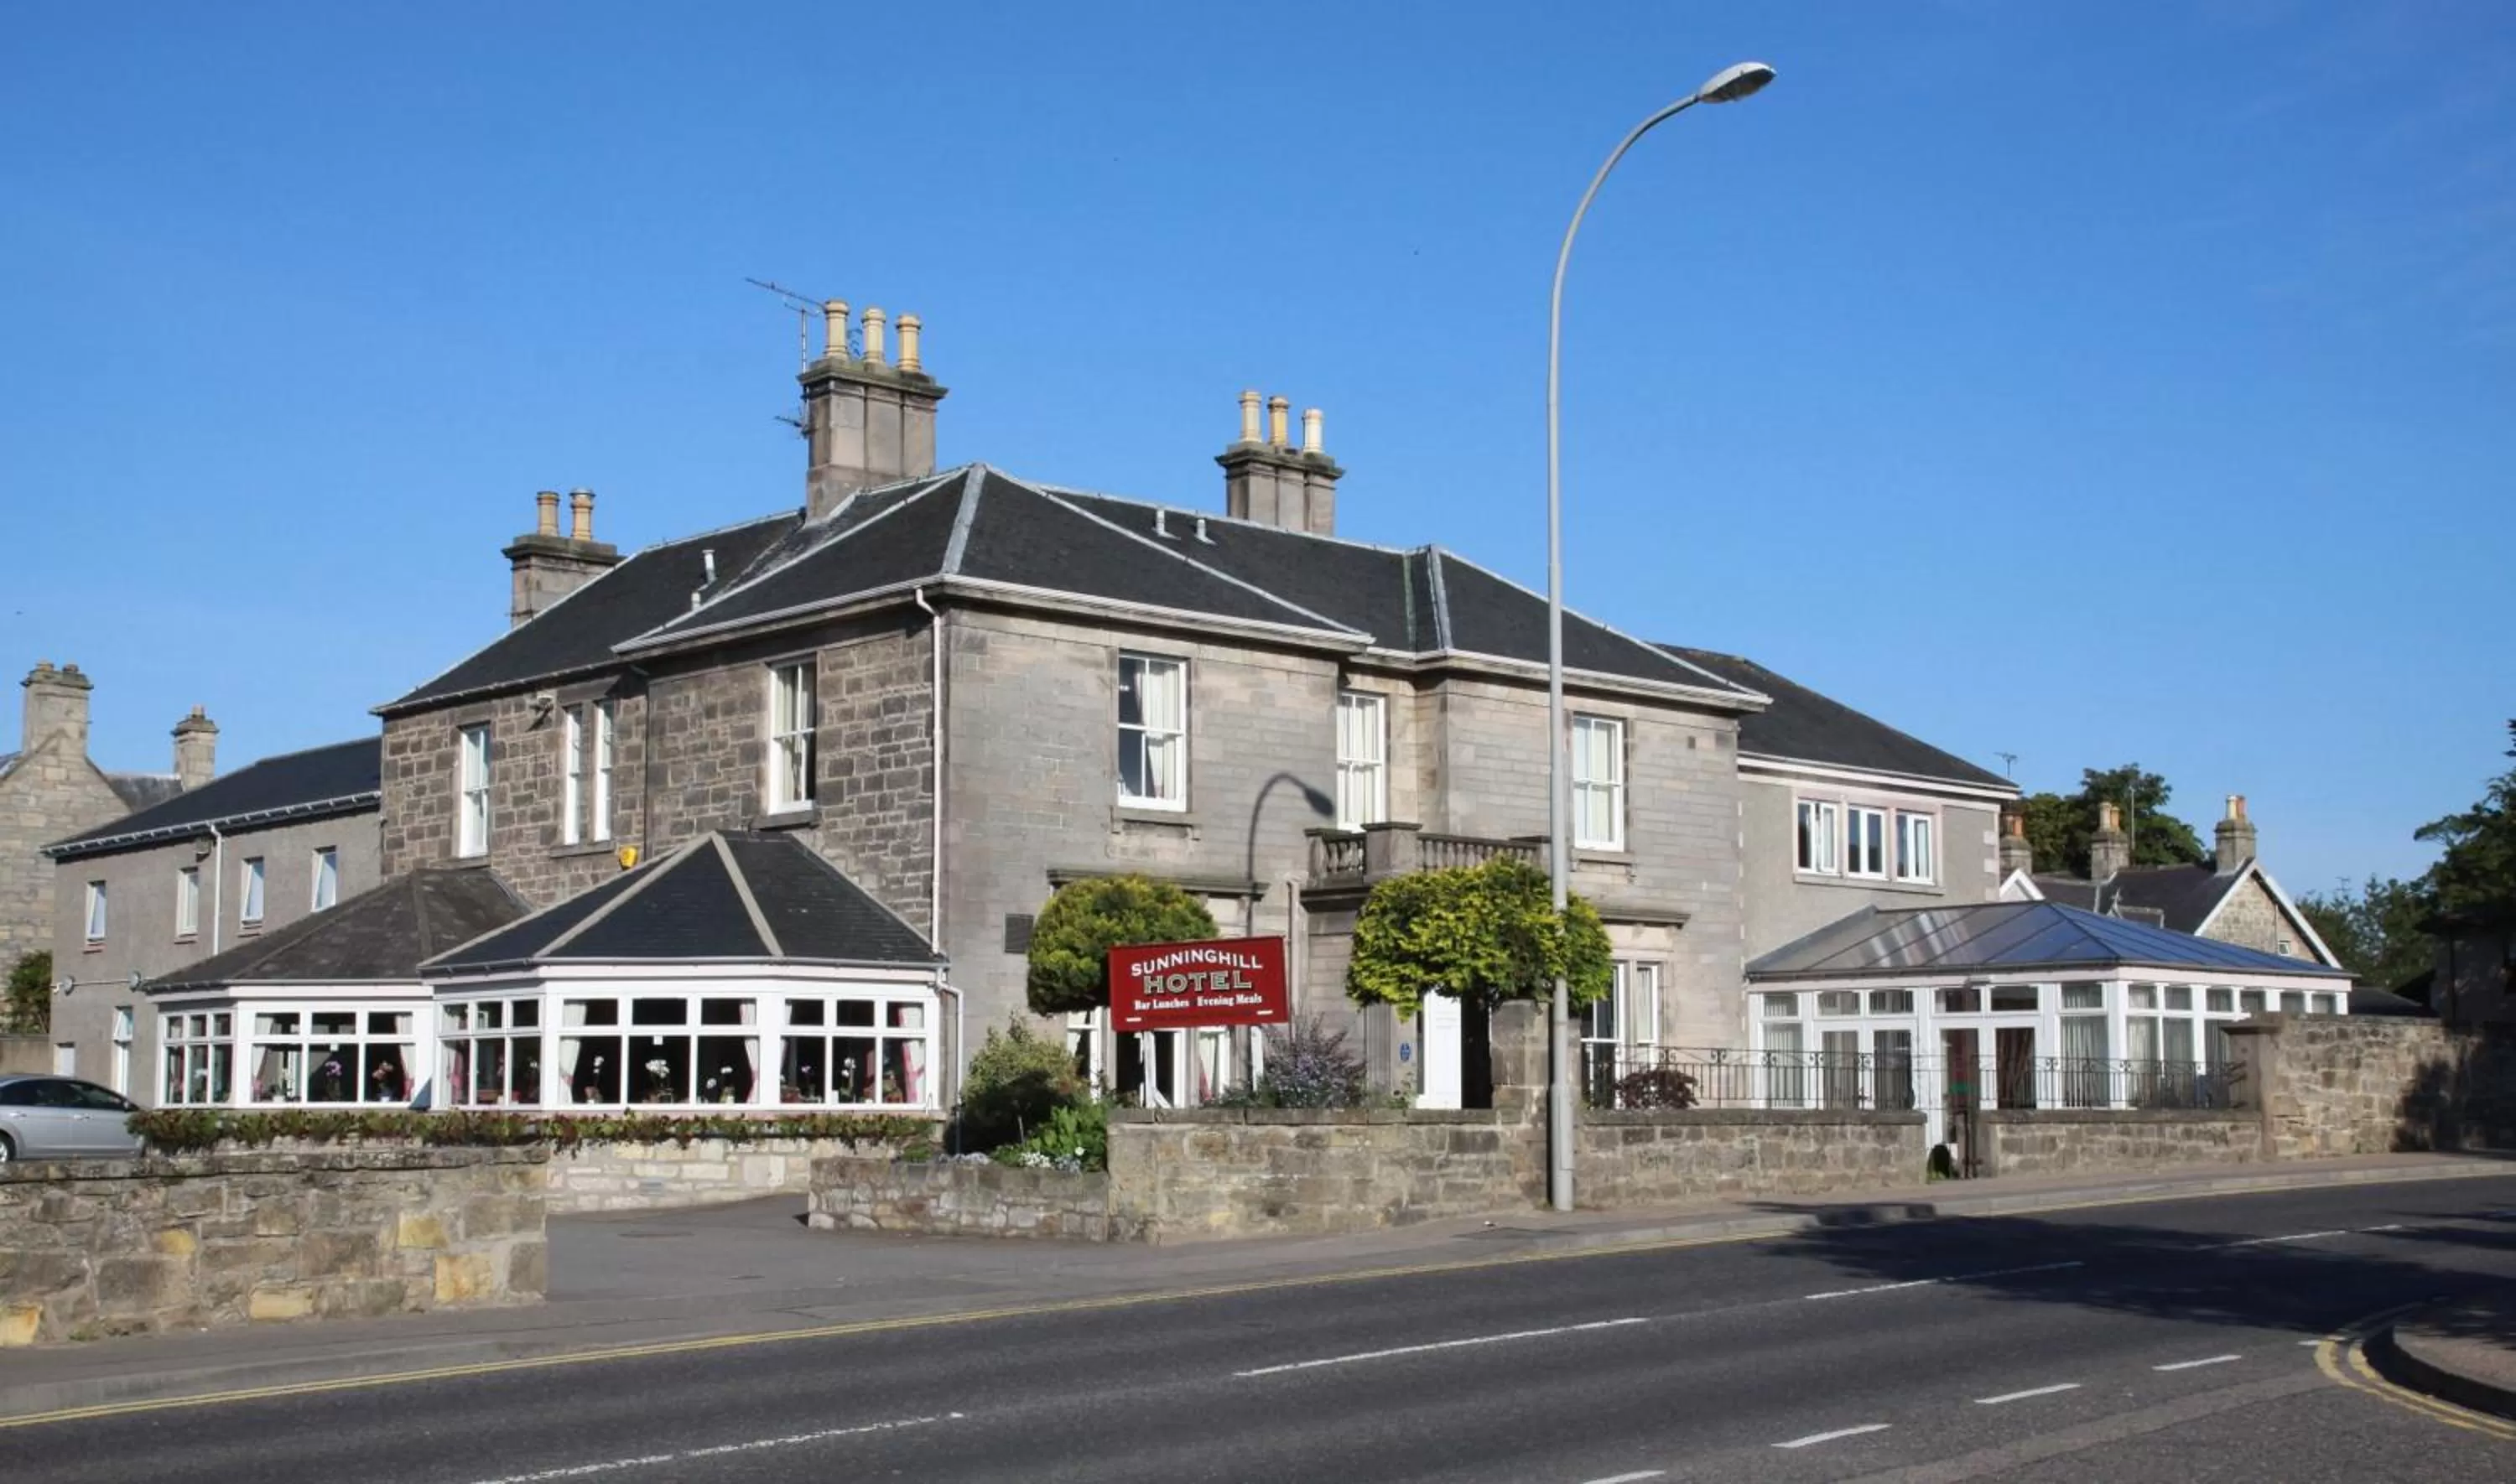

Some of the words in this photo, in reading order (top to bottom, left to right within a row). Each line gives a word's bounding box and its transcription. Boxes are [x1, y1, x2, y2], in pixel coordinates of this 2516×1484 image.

[1131, 949, 1263, 976] SUNNINGHILL
[1144, 970, 1252, 994] HOTEL
[1135, 999, 1150, 1010] Bar
[1152, 998, 1189, 1009] Lunches
[1197, 995, 1234, 1006] Evening
[1236, 993, 1262, 1004] Meals
